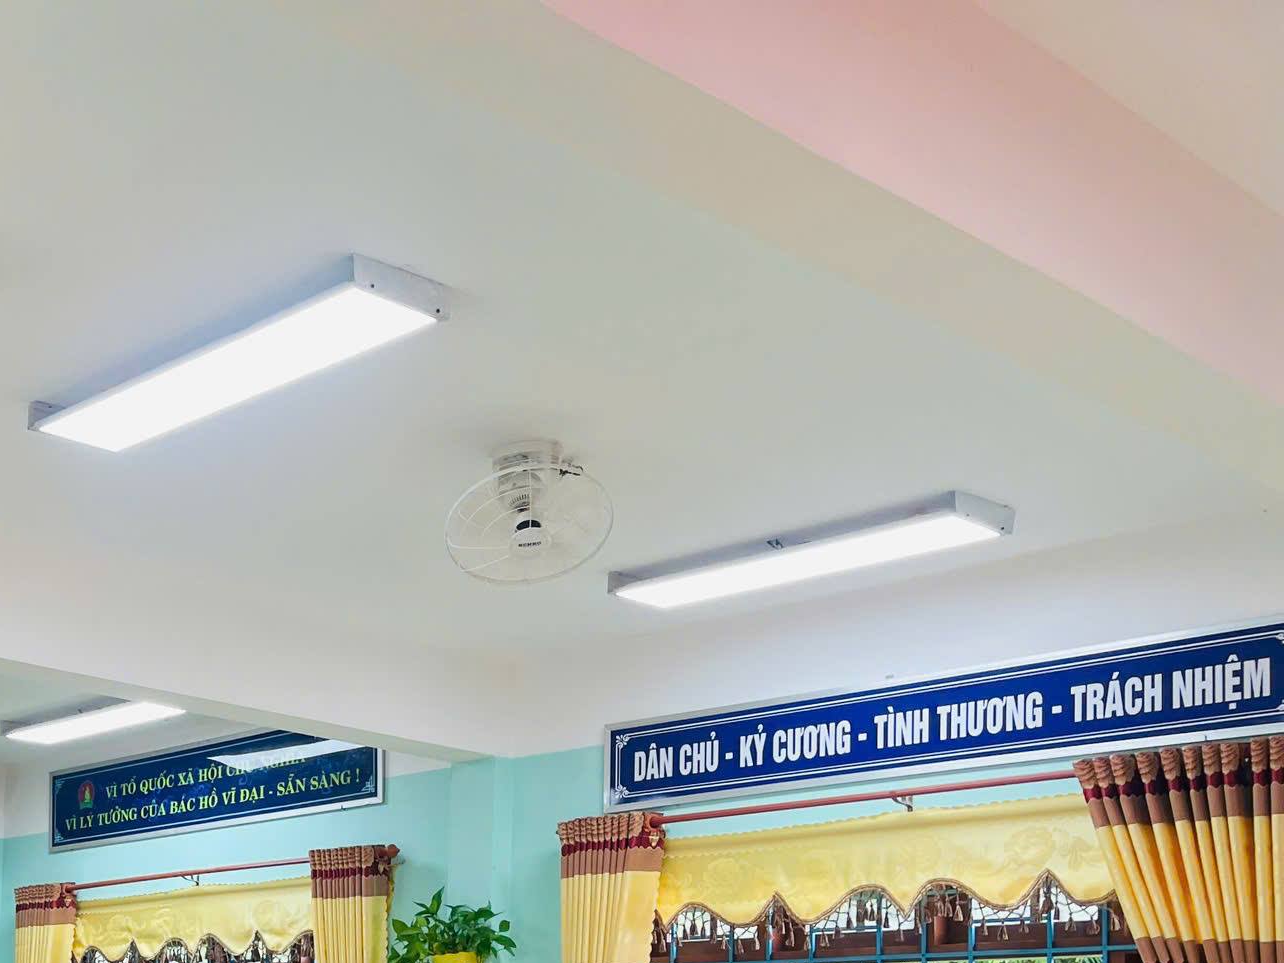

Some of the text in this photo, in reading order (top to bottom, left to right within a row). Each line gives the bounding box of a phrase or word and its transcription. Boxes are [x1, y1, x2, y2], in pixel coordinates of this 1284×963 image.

[634, 654, 1271, 782] DÂN CHỦ - KỶ CƯƠNG - TÌNH THƯƠNG - TRÁCH NHIỆM
[66, 818, 77, 831] VÌ
[98, 804, 137, 825] TƯỞNG
[140, 798, 166, 820] CỦA
[169, 794, 195, 815] BÁC
[198, 788, 218, 809] HỒ
[222, 786, 237, 805] VĨ
[240, 784, 265, 804] ĐẠI
[276, 773, 307, 797] SẴN
[310, 771, 352, 791] SÀNG
[105, 783, 118, 799] VÌ
[120, 776, 137, 797] TỔ
[140, 770, 174, 795] QUỐC
[178, 769, 194, 786] XÃ
[198, 764, 223, 784] HỘI
